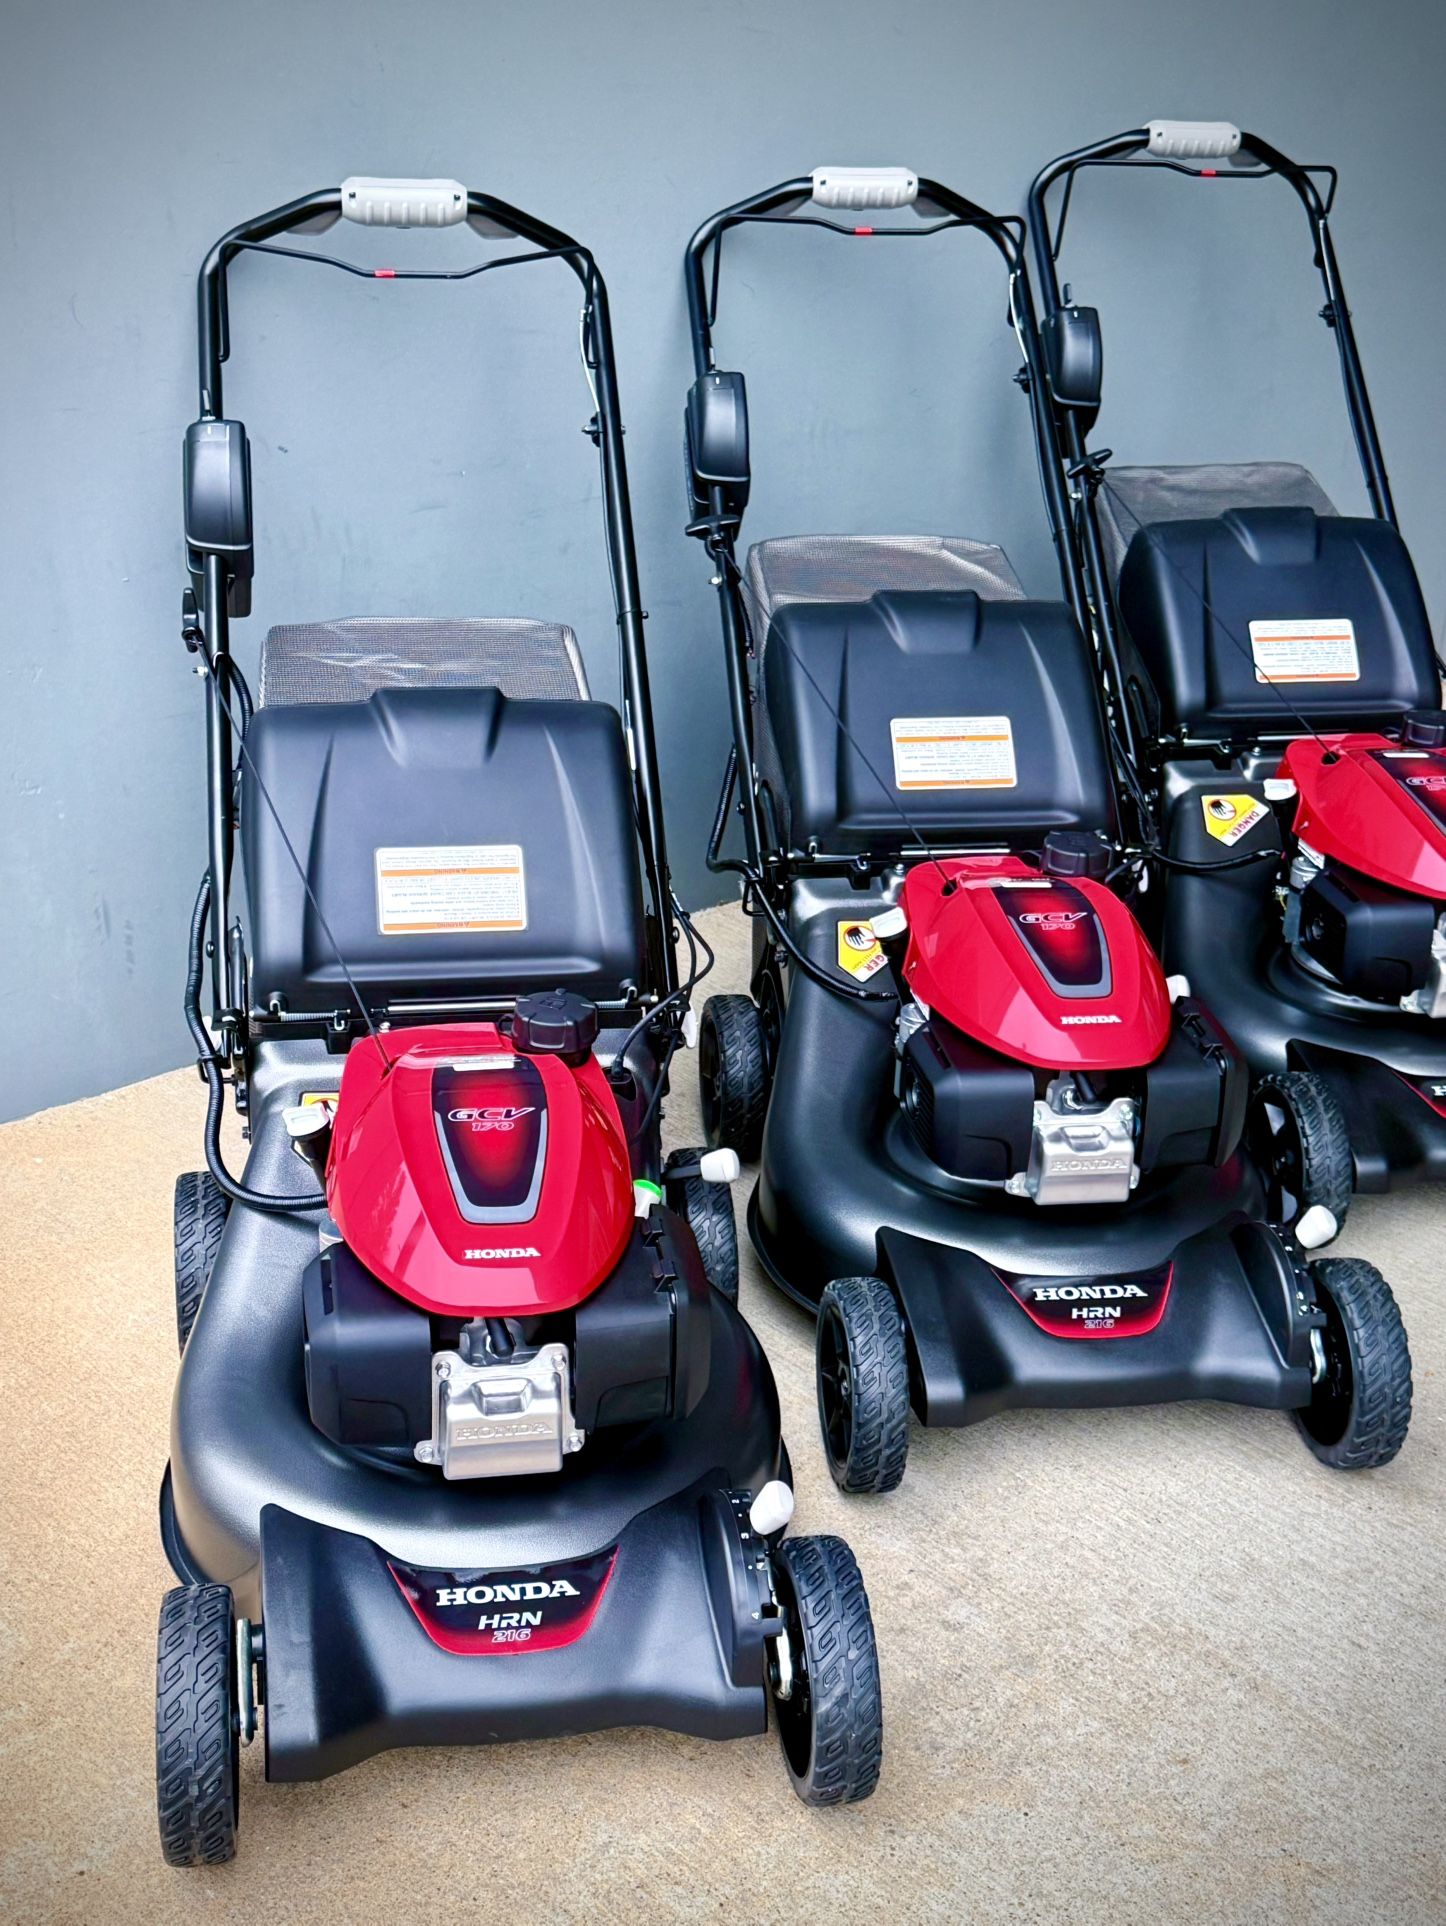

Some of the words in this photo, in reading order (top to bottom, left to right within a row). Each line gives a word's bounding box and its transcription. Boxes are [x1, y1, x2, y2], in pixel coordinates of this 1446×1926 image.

[1406, 776, 1446, 786] GC
[1229, 811, 1260, 837] DANGER
[1019, 912, 1087, 923] GCV
[864, 954, 885, 971] GER
[1060, 1015, 1122, 1025] HONDA
[448, 1107, 536, 1121] GCV
[471, 1122, 515, 1131] 170
[1051, 1159, 1128, 1171] HONDA
[464, 1247, 541, 1259] HONDA
[1033, 1285, 1148, 1300] HONDA
[1071, 1307, 1121, 1319] HRN
[1083, 1319, 1115, 1328] 216
[456, 1422, 553, 1440] HONDA
[436, 1580, 580, 1606] HONDA
[478, 1611, 543, 1630] HRN
[751, 1611, 760, 1620] 4
[491, 1628, 532, 1643] 216
